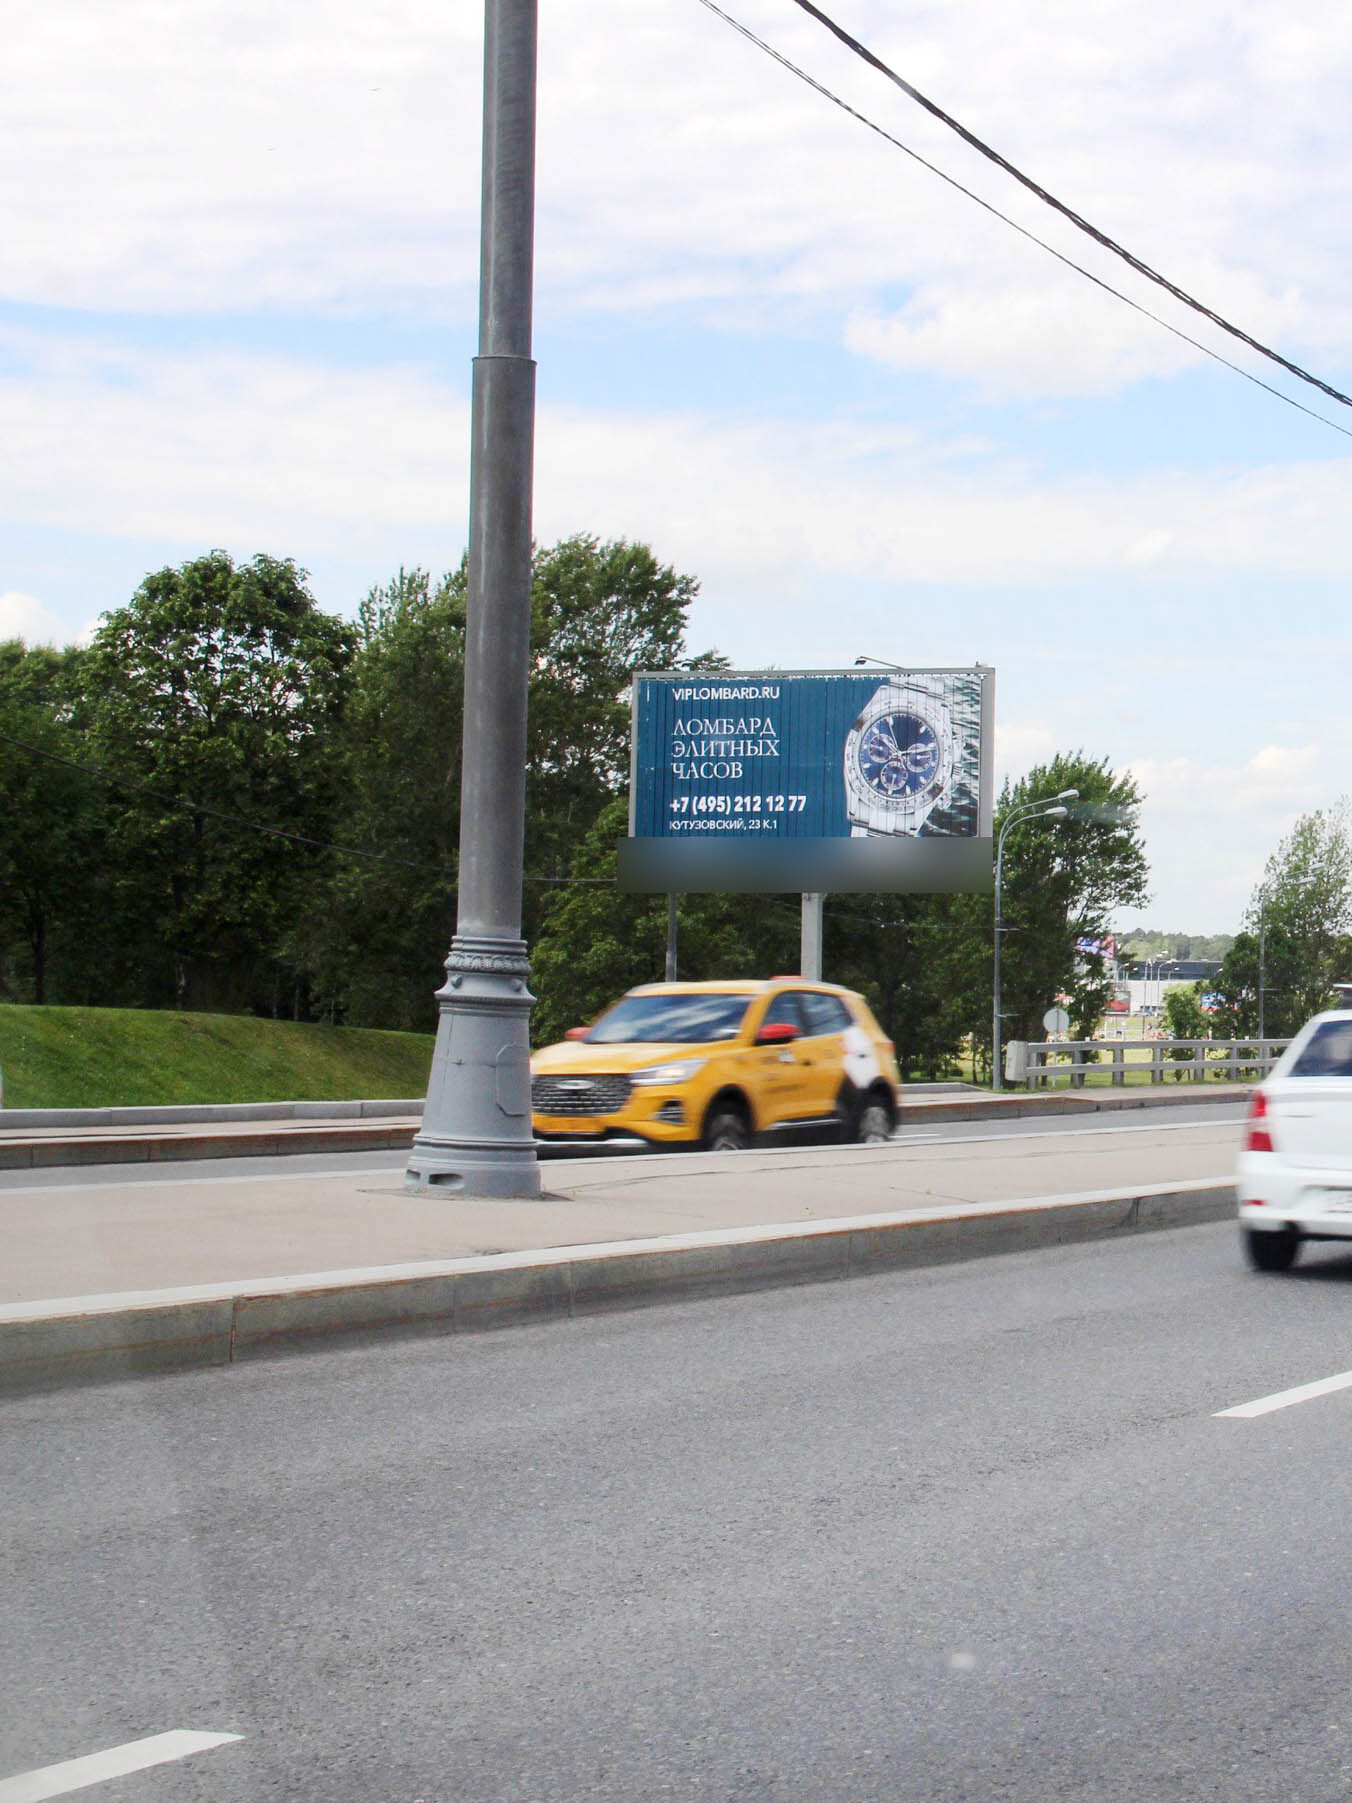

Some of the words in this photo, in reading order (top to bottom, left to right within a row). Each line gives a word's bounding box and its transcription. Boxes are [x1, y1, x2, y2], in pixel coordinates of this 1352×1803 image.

[672, 686, 780, 700] VIPLOMBARD.RU
[672, 717, 776, 737] ЛОМБАРД
[671, 739, 780, 758] ЭЛИТНЫХ
[671, 761, 743, 780] ЧАСОВ
[669, 796, 689, 813] +7
[692, 796, 730, 815] (495)
[733, 796, 761, 812] 212
[766, 795, 785, 812] 12
[788, 795, 807, 812] 77
[669, 818, 747, 830] КУТУЗОВСКИЙ,
[748, 820, 761, 829] 23
[763, 819, 777, 829] К.1
